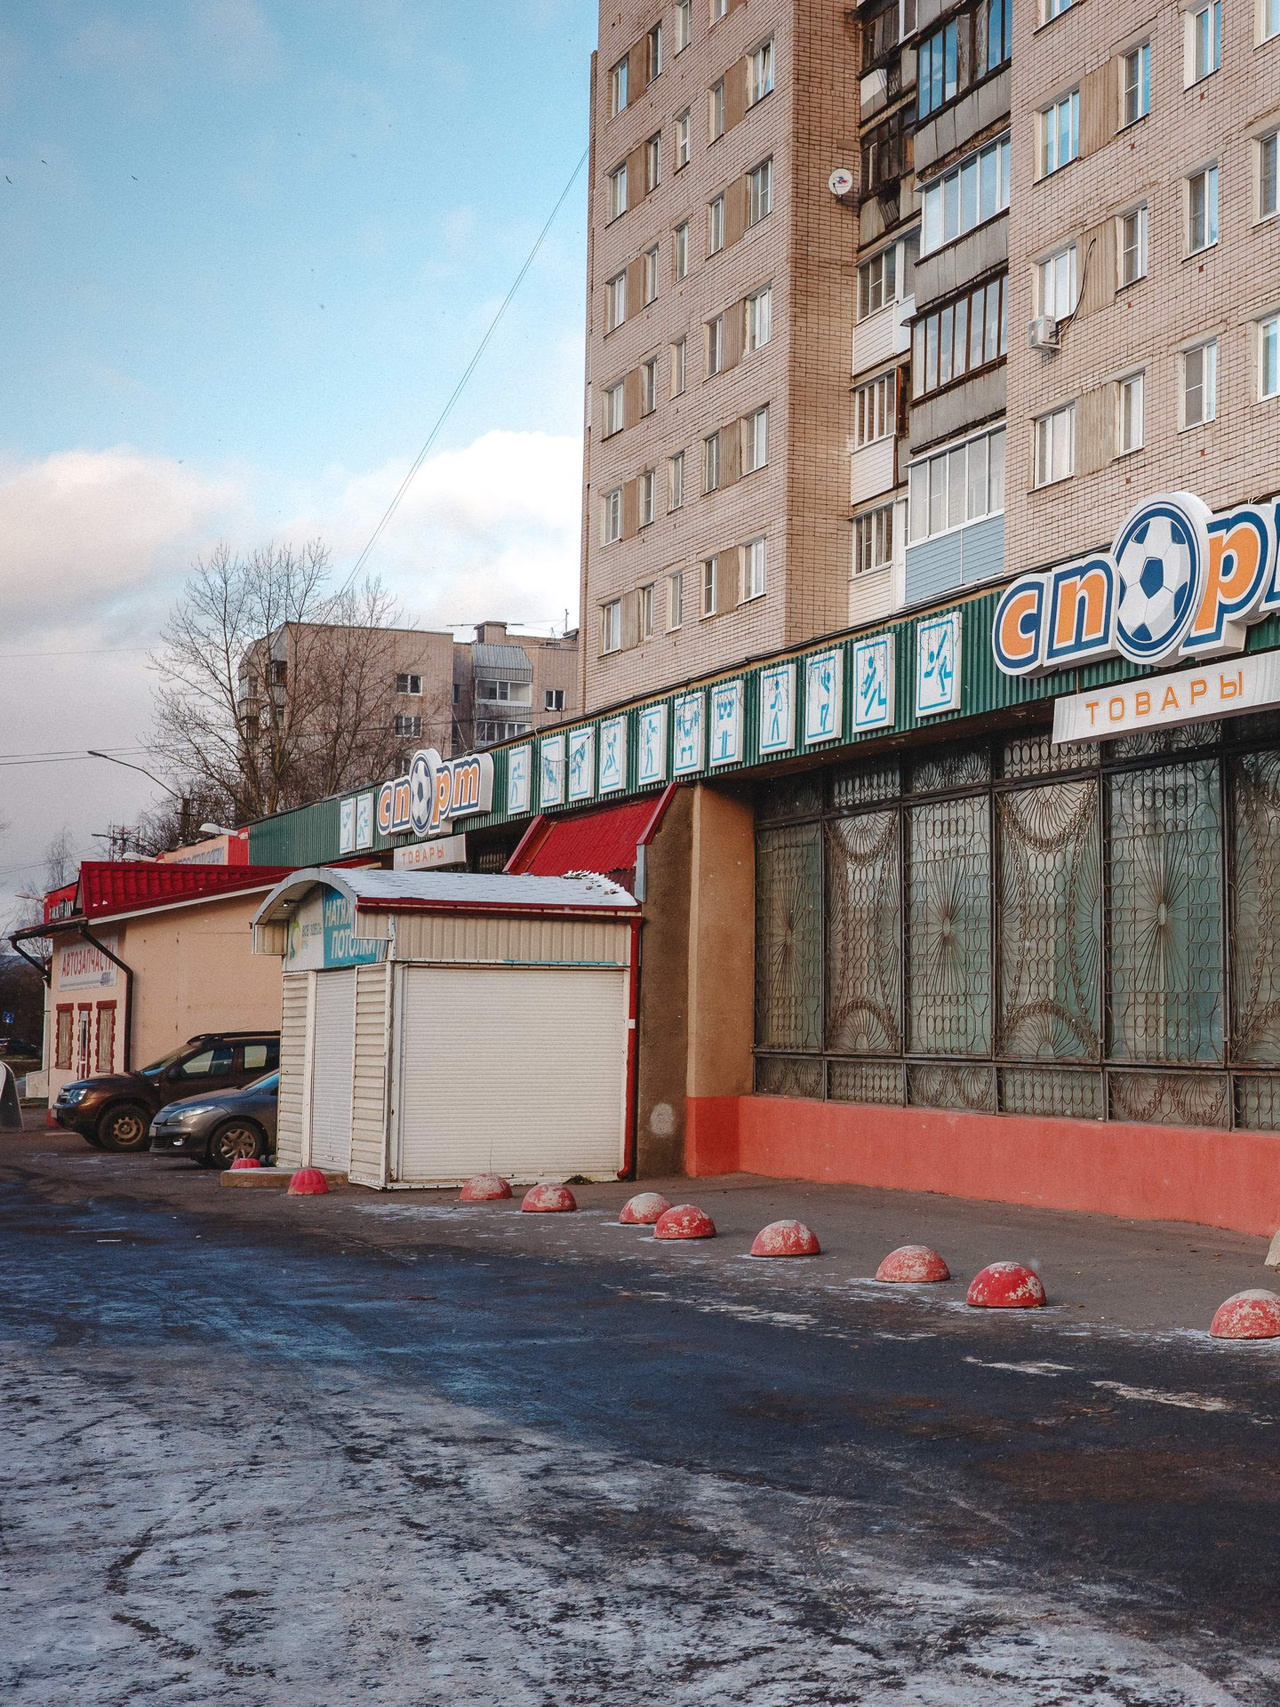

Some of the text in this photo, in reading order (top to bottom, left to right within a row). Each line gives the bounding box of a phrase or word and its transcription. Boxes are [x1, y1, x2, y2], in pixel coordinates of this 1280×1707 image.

[1085, 670, 1243, 725] ТОВАРЫ
[401, 845, 445, 866] ТОВАРЫ
[61, 945, 114, 977] АВТОЗАПЧАСТИ
